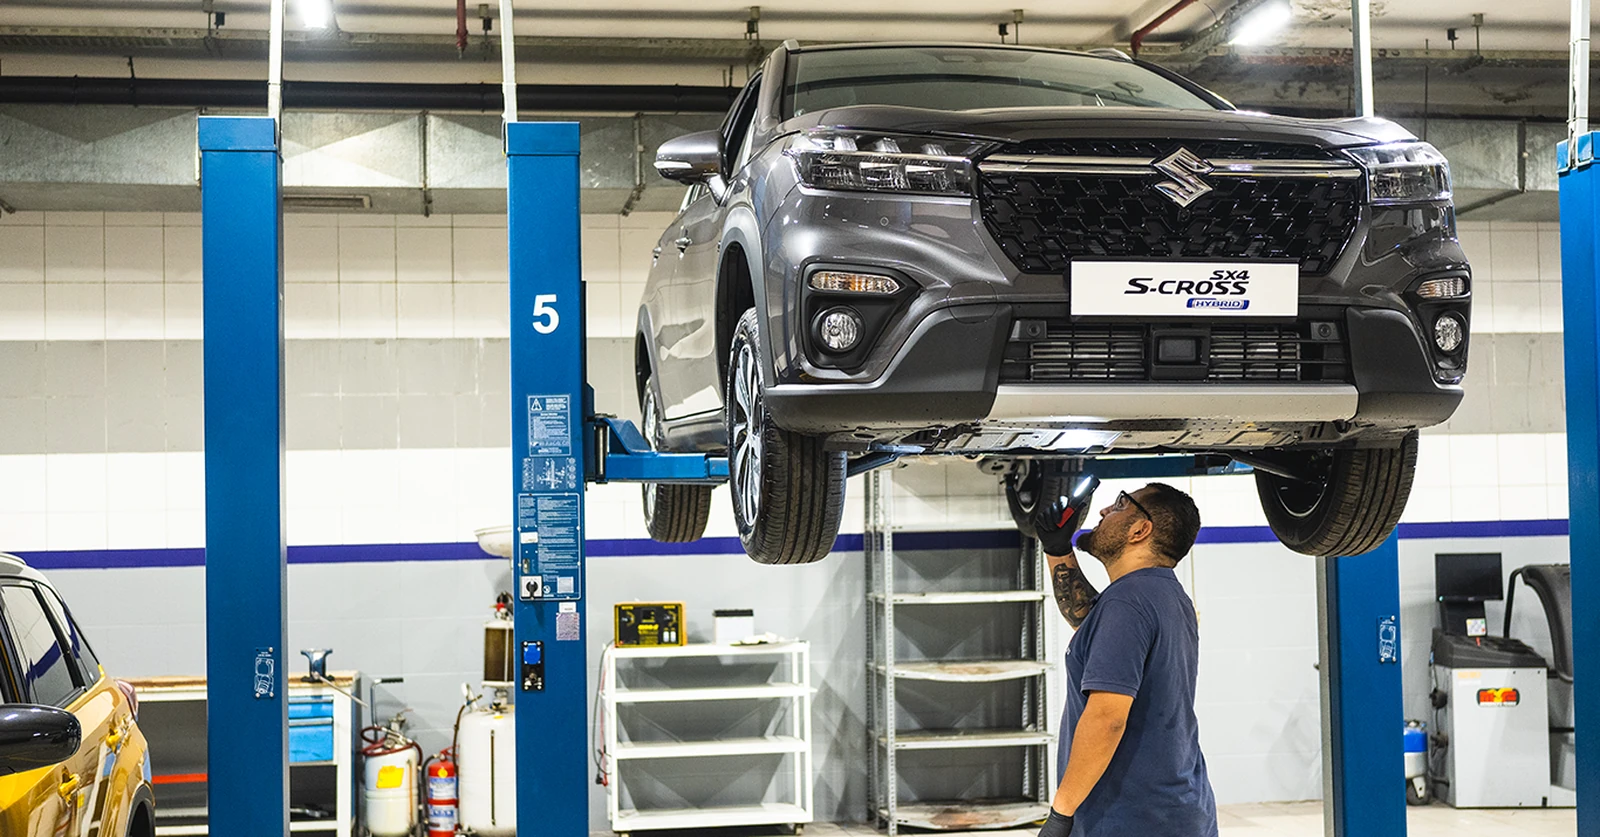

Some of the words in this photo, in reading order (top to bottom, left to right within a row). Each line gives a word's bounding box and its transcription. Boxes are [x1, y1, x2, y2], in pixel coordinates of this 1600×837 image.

[1209, 270, 1250, 280] SX4
[1124, 278, 1250, 295] S-CROSS
[1193, 299, 1243, 308] HYBRID
[533, 294, 560, 334] 5
